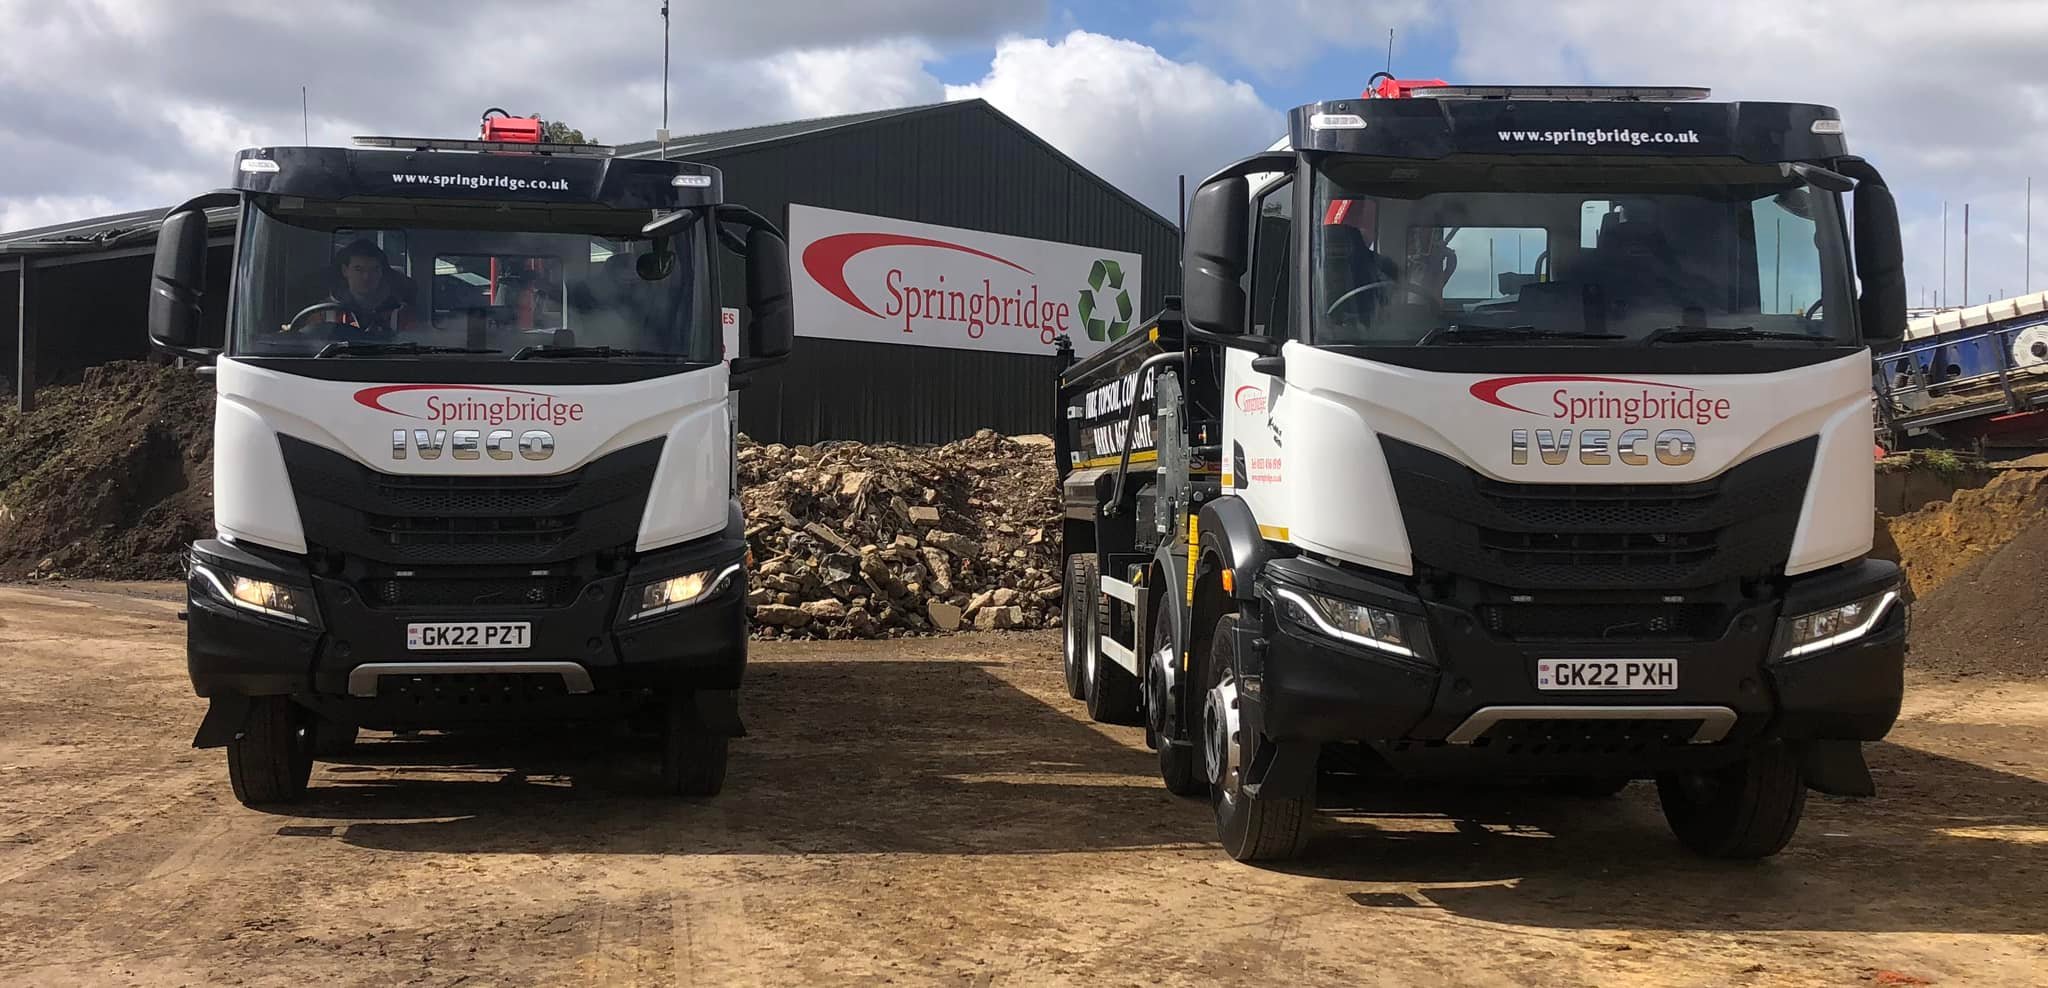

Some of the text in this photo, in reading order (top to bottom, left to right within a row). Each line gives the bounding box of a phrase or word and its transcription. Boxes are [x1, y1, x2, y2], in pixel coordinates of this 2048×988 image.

[1498, 128, 1699, 145] www.springbridge.co.uk
[392, 174, 569, 190] www.springbridge.co.uk
[886, 269, 1069, 344] Springbridge
[427, 396, 584, 425] Springbridge
[1553, 389, 1731, 425] Springbridge
[392, 429, 555, 460] IVECO
[1512, 428, 1697, 466] IVECO
[422, 625, 527, 645] GK22 PZT
[1555, 663, 1673, 685] GK22 PXH
